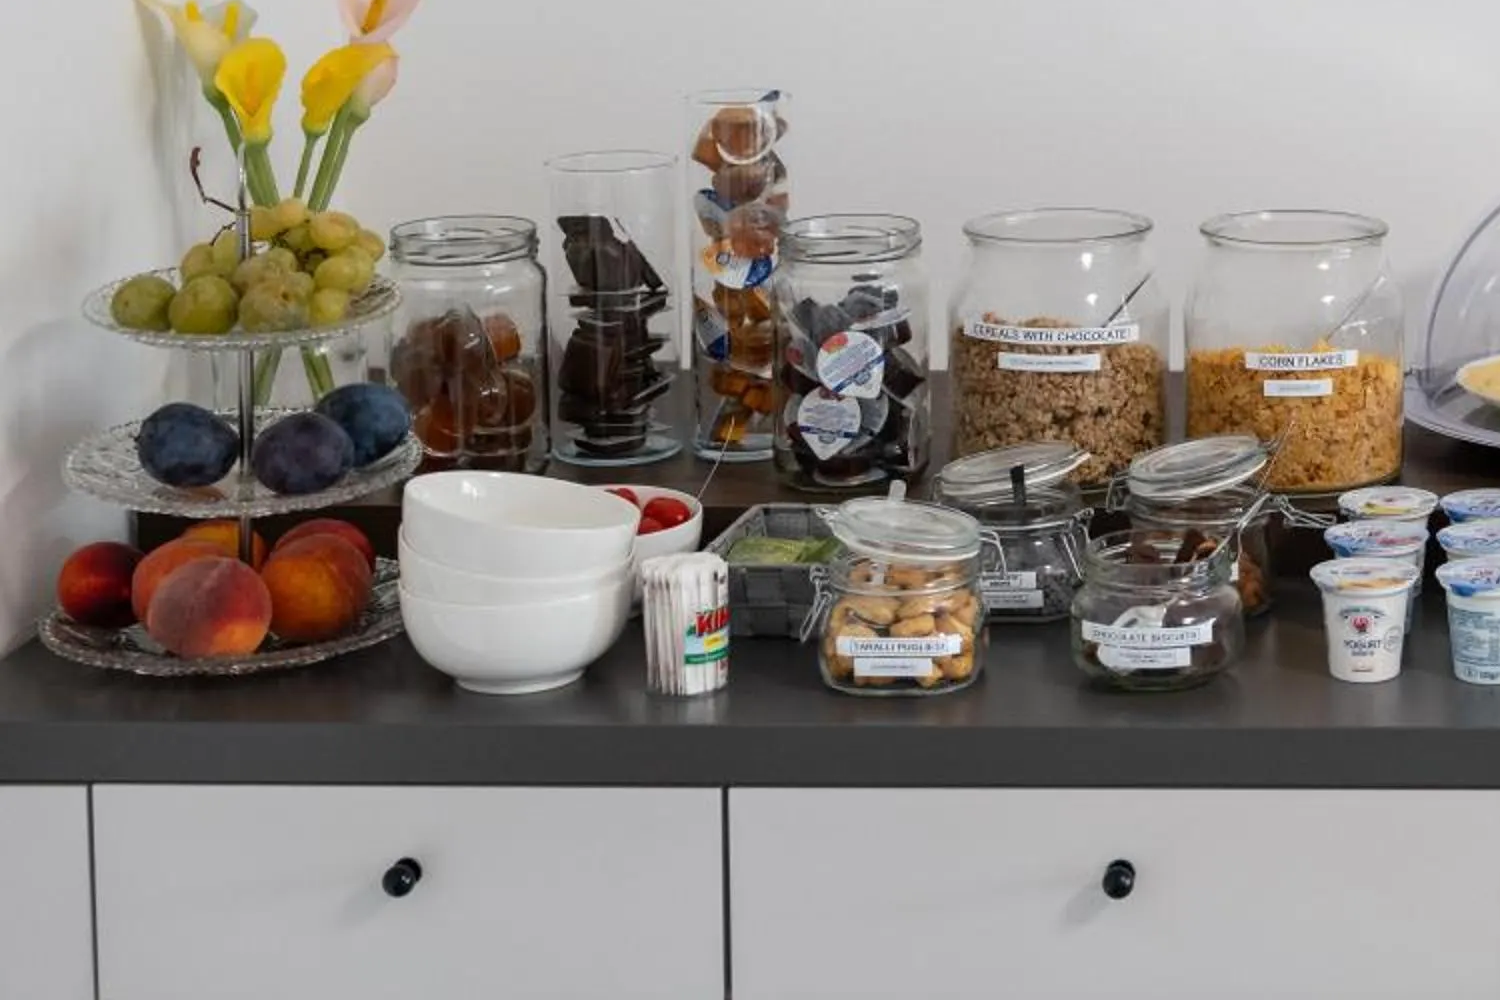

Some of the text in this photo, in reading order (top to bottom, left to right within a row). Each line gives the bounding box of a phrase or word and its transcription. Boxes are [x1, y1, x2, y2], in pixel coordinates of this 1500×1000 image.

[973, 323, 1020, 340] CEREALS
[1023, 331, 1053, 342] WITH
[1259, 353, 1344, 368] CORN FLAKES
[1343, 639, 1382, 649] YOGURT
